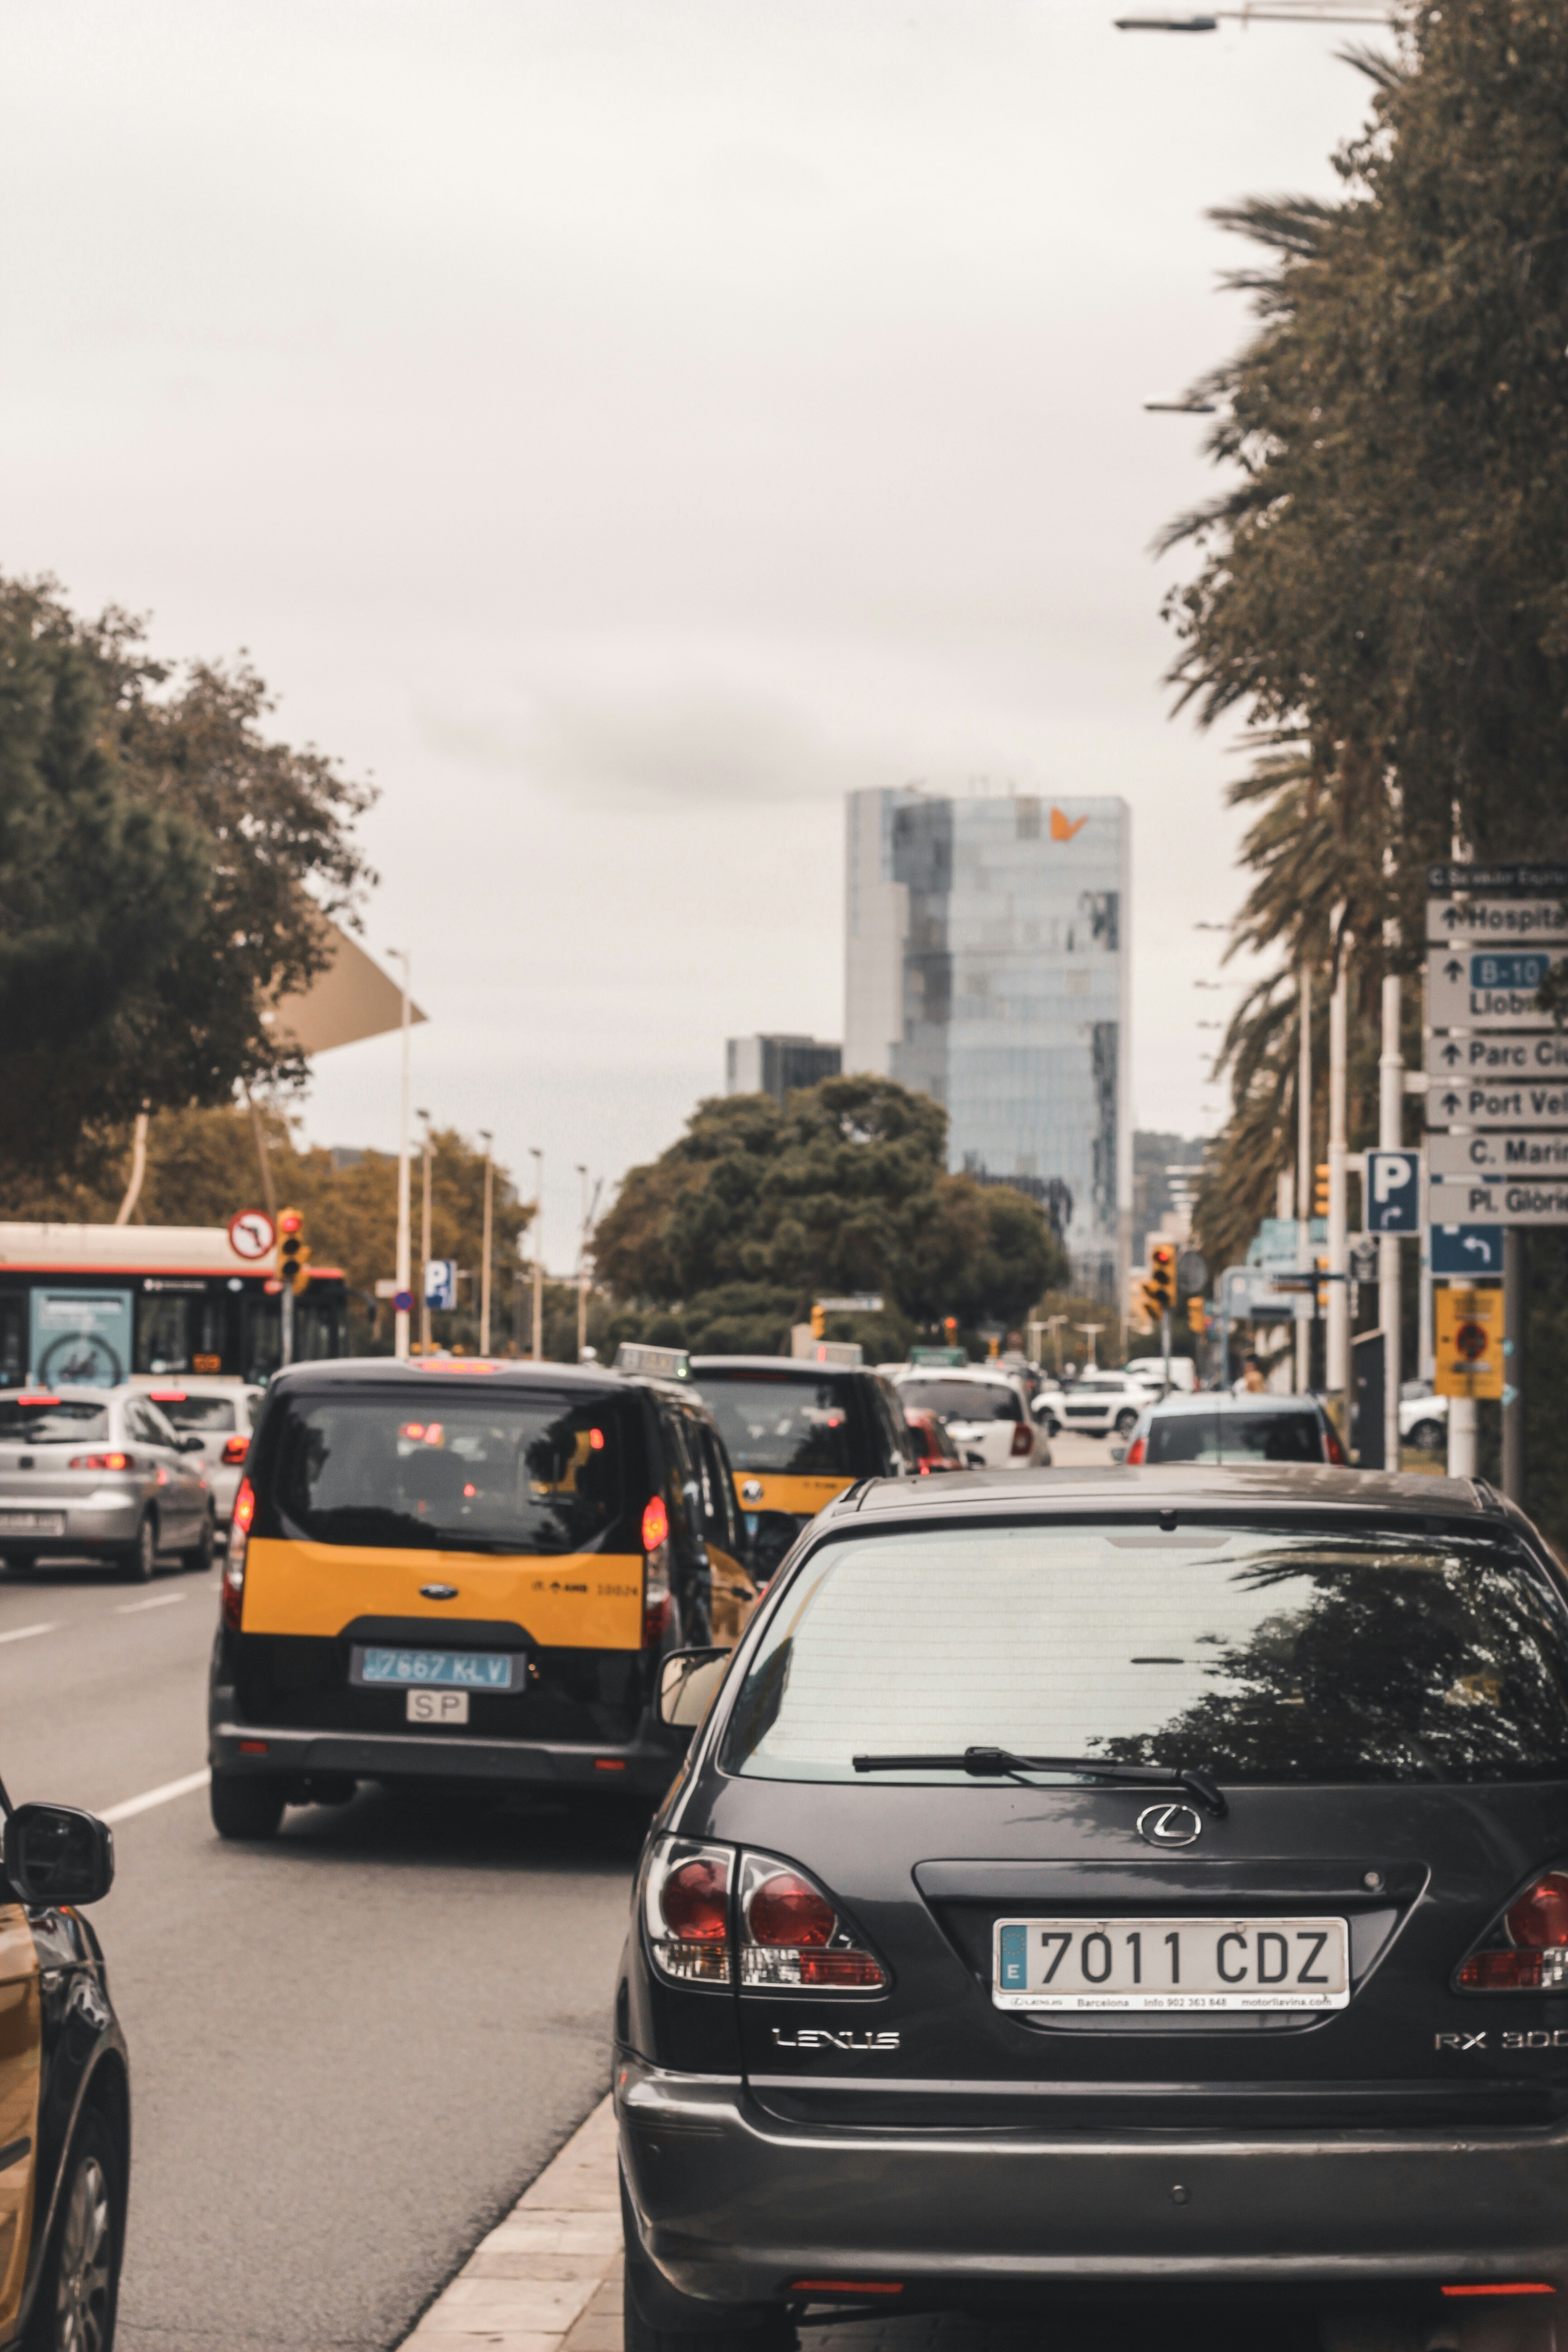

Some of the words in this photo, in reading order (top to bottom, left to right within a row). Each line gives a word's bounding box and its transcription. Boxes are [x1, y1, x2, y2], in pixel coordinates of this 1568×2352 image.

[1481, 960, 1538, 984] B-10
[1469, 1041, 1526, 1066] Parc
[1469, 1090, 1522, 1115] Port
[1470, 1139, 1496, 1165] C.
[1375, 1156, 1410, 1202] P
[415, 1695, 460, 1719] SP
[1007, 1964, 1019, 1979] E
[1041, 1931, 1180, 1984] 7011
[1216, 1931, 1328, 1984] CDZ
[1077, 1998, 1129, 2007] Barcelona
[1144, 1998, 1164, 2007] Info
[772, 2028, 900, 2049] LEXUS
[1435, 2031, 1487, 2050] RX
